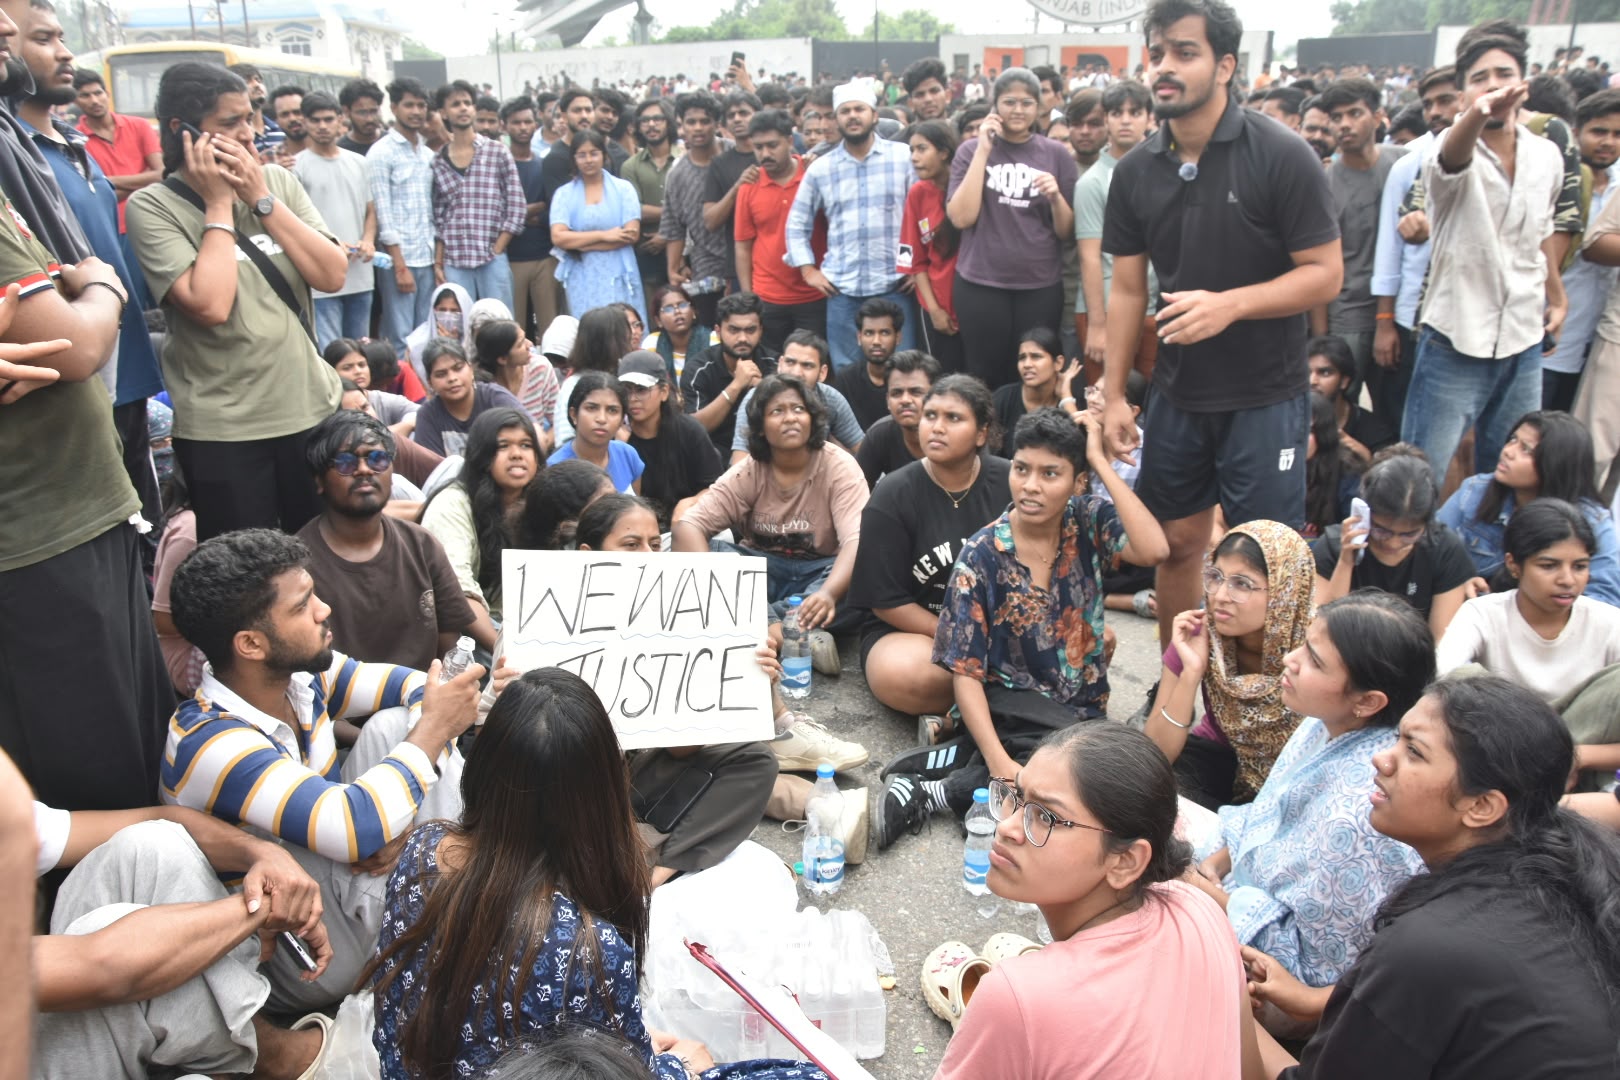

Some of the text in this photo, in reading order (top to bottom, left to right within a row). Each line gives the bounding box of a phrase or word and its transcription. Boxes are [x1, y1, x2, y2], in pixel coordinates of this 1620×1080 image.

[912, 541, 953, 585] NEW
[517, 561, 768, 636] WE WANT
